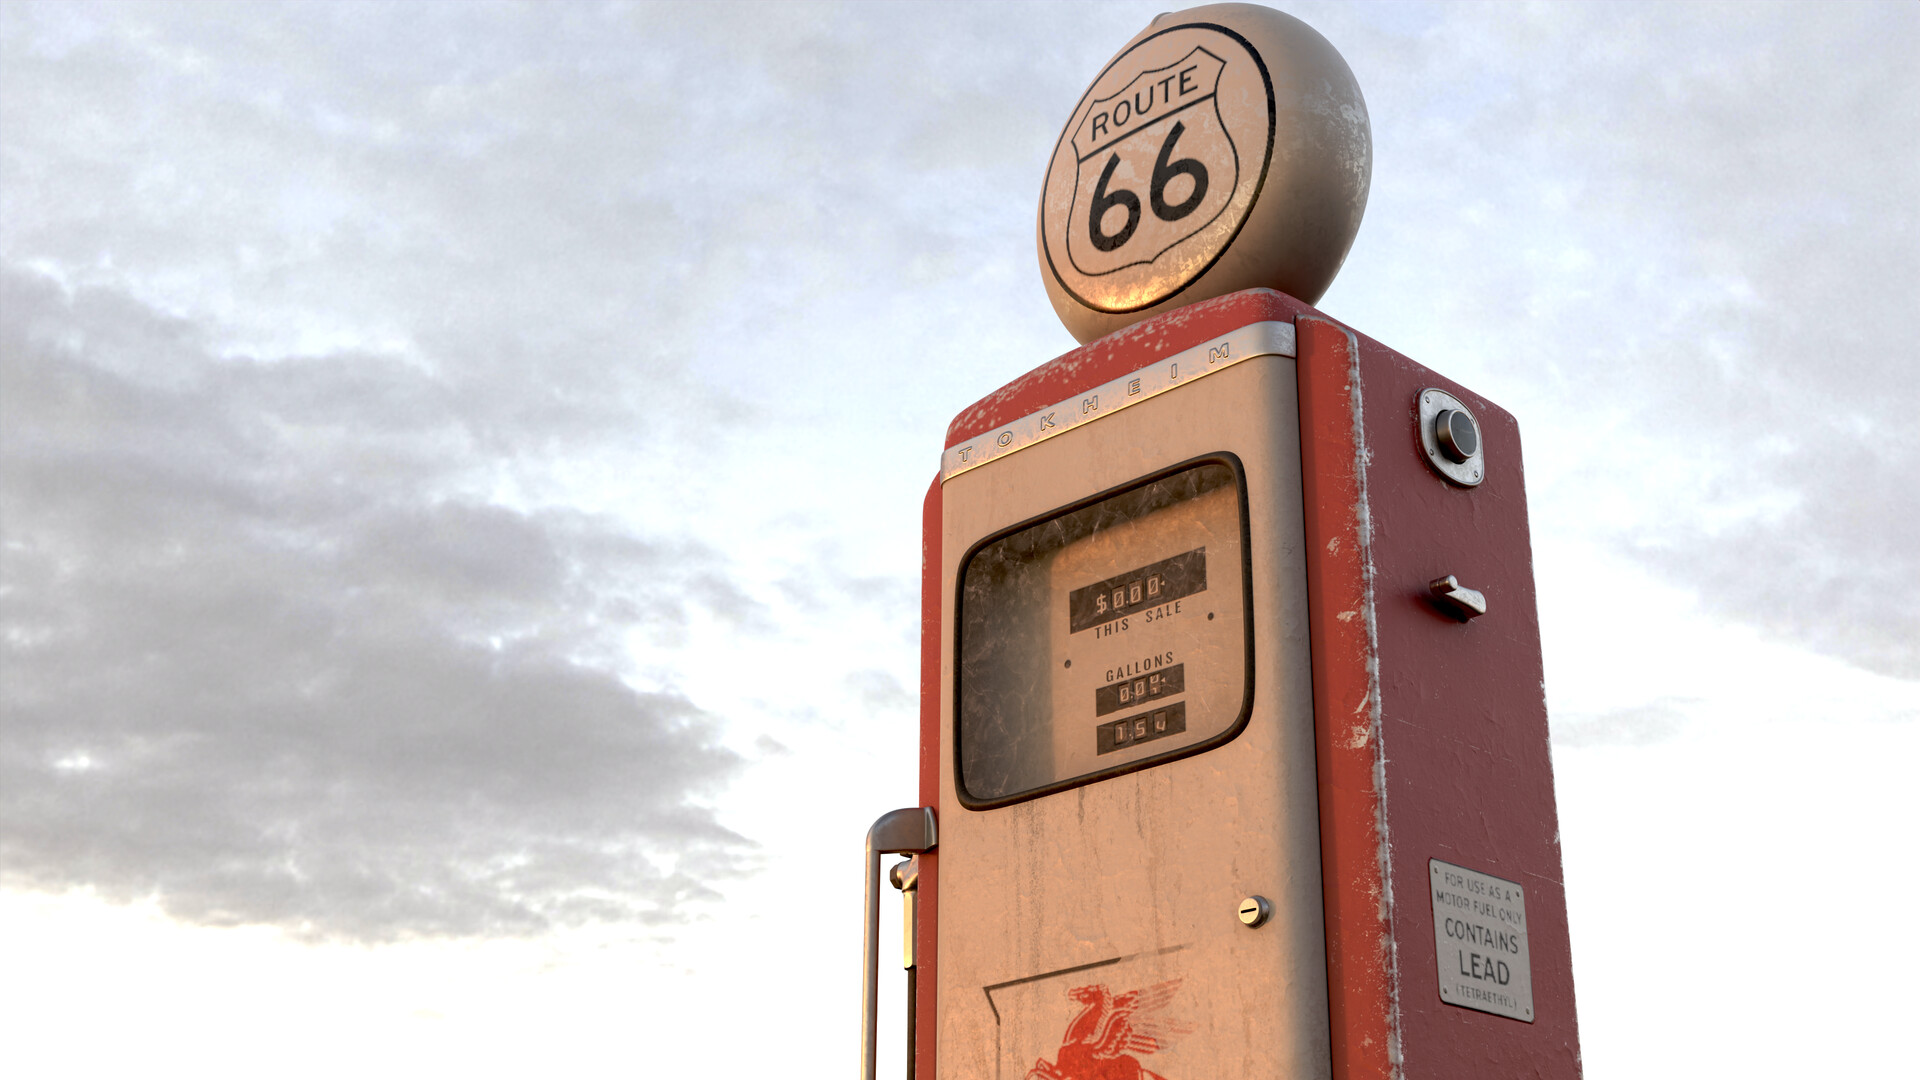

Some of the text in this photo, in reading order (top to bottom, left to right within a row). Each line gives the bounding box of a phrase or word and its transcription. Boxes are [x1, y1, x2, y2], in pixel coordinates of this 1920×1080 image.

[1091, 64, 1199, 142] ROUTE
[1088, 120, 1209, 252] 66
[958, 343, 1230, 463] TOKHEIM
[1094, 601, 1182, 639] THIS SALE
[1106, 652, 1174, 682] GALLONS
[1445, 872, 1512, 902] FOR USE AS A
[1436, 890, 1522, 926] MOTOR FUEL ONLY
[1445, 917, 1519, 954] CONTAINS
[1459, 949, 1510, 986] LEAD
[1456, 984, 1517, 1010] (TETRAETHYL)
